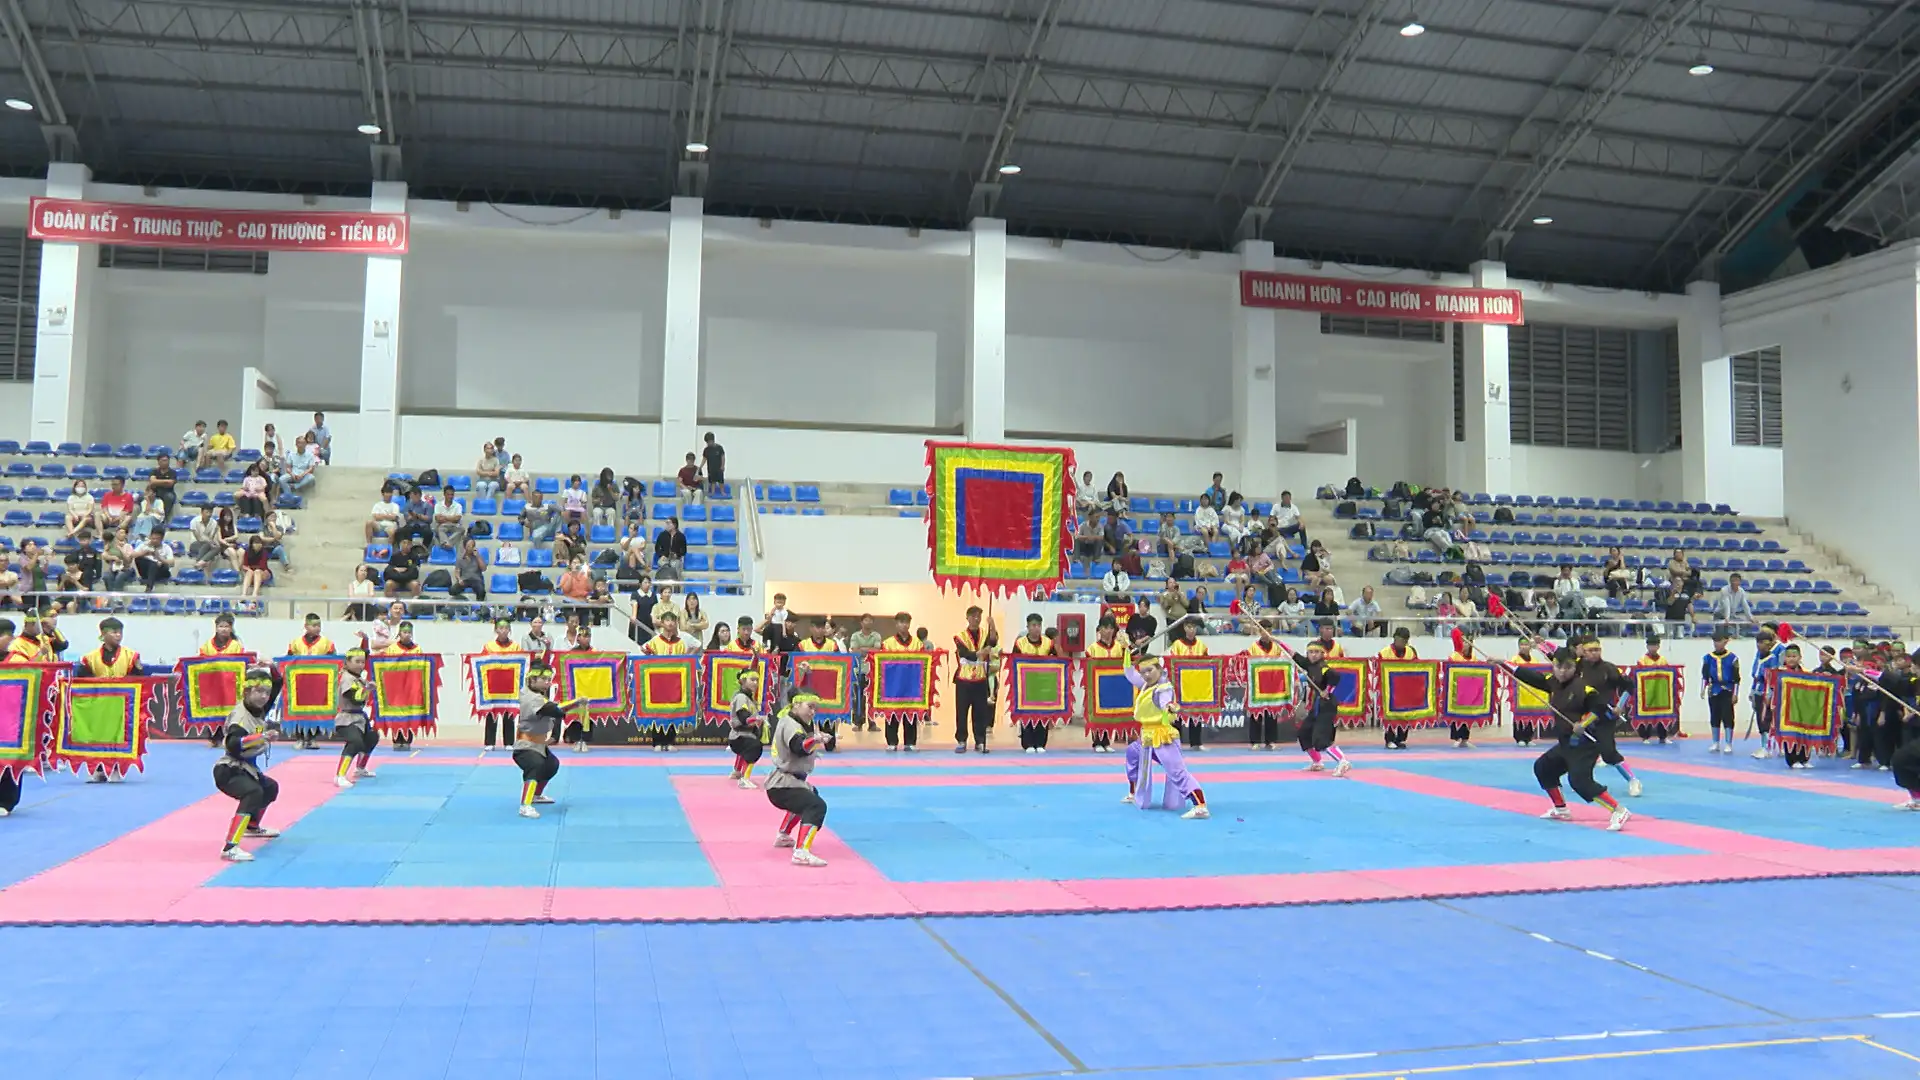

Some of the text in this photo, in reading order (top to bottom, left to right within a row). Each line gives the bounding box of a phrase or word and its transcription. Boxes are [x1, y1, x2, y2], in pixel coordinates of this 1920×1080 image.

[43, 210, 85, 230] ĐOÀN
[90, 209, 119, 232] KẾT
[133, 216, 181, 236] TRUNG
[186, 219, 223, 241] THỰC
[238, 222, 267, 238] CAO
[271, 222, 326, 243] THƯỢNG
[340, 219, 372, 241] TIẾN
[377, 222, 397, 245] BỘ
[1252, 279, 1305, 302] NHANH
[1310, 284, 1341, 304] HƠN
[1356, 288, 1386, 308] CAO
[1390, 290, 1420, 310] HƠN
[1435, 295, 1479, 316] MẠNH
[1483, 295, 1513, 314] HƠN
